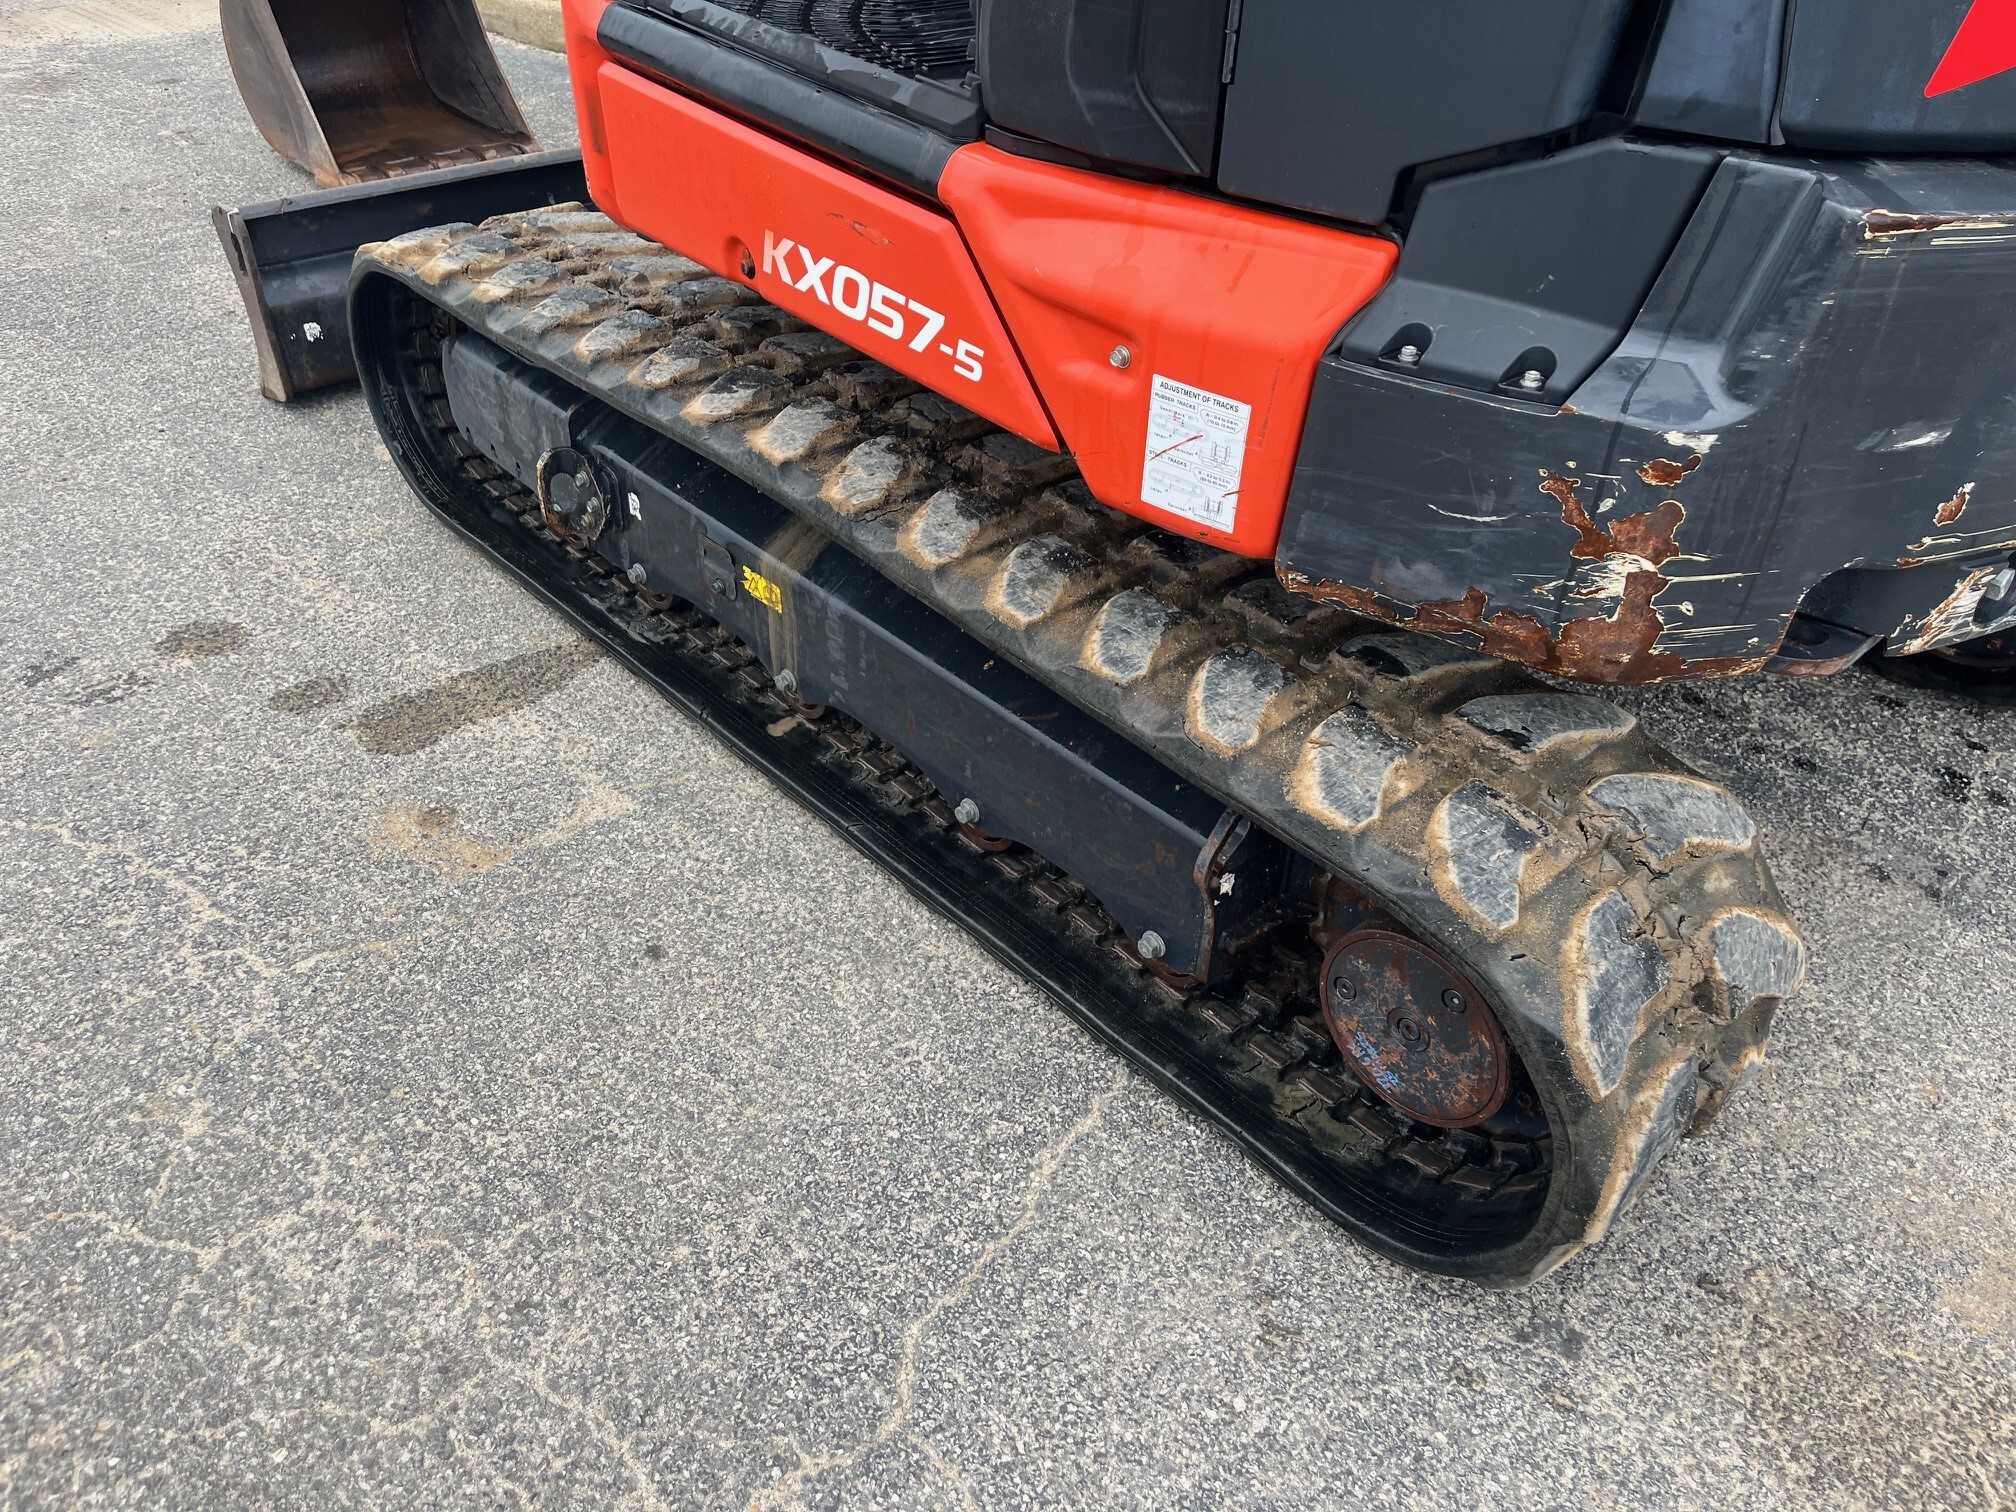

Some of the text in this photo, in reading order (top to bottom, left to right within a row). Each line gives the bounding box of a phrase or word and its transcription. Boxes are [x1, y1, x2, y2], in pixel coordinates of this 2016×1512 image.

[762, 229, 984, 382] KX057-5
[1154, 392, 1196, 411] RUBBER TRACKS
[1160, 381, 1239, 413] ADJUSTMENT OF TRACKS
[1149, 449, 1187, 468] STEL TRACKS
